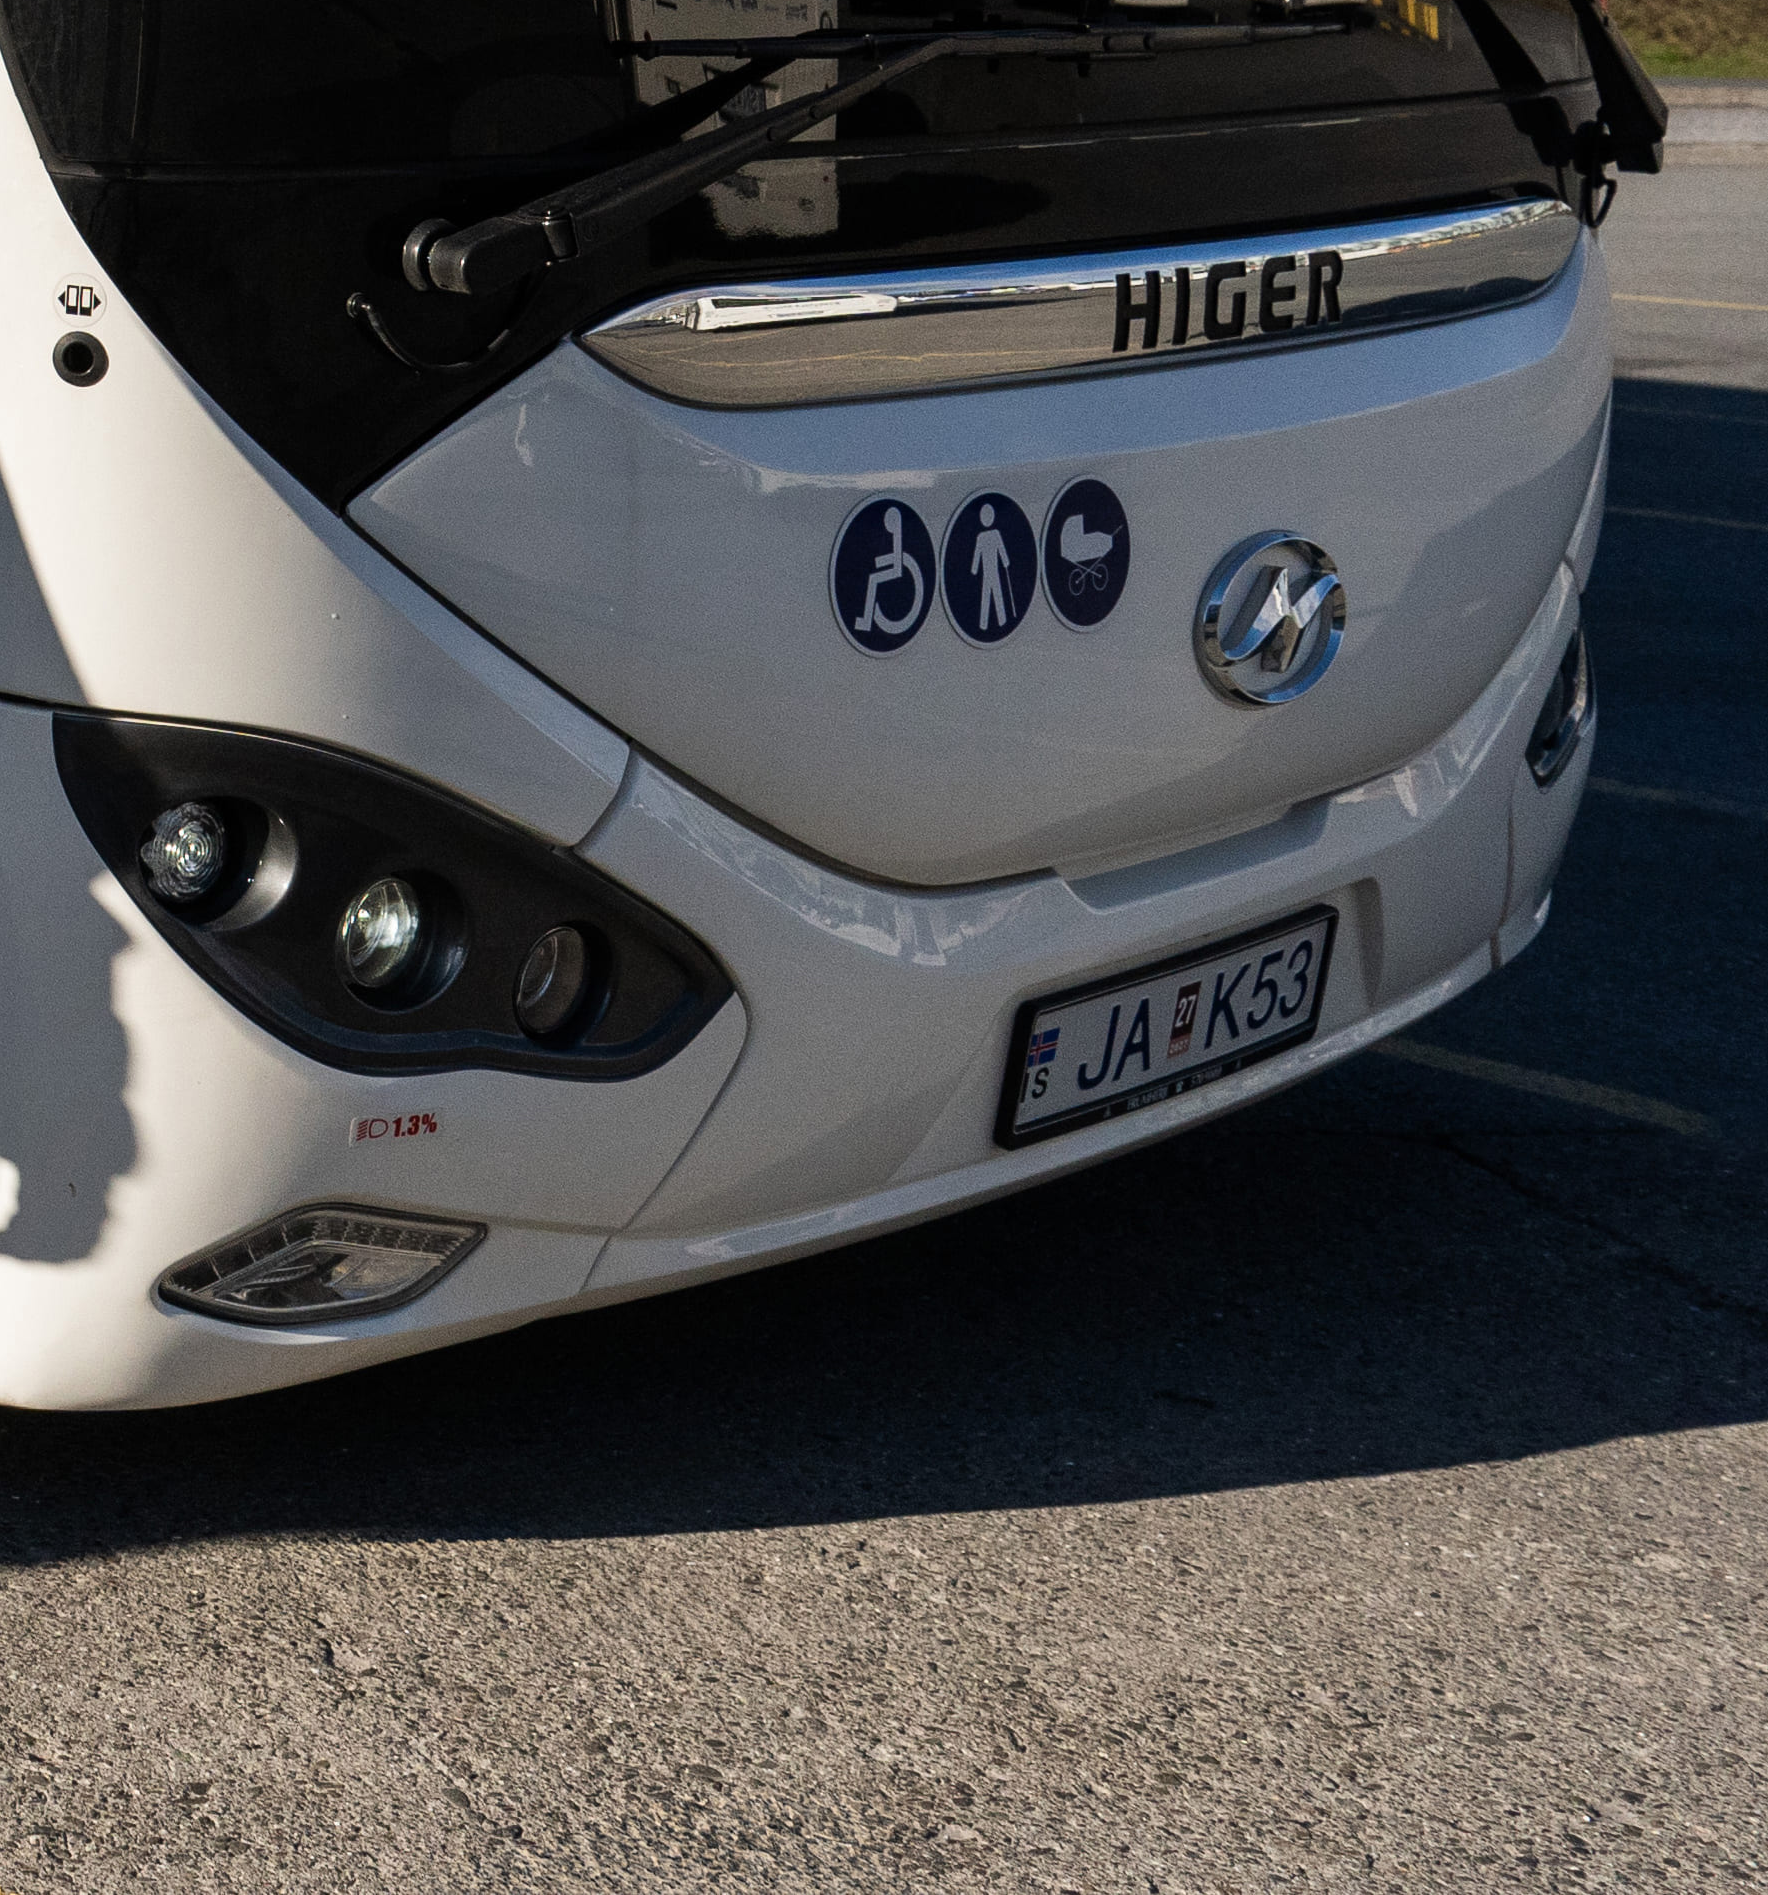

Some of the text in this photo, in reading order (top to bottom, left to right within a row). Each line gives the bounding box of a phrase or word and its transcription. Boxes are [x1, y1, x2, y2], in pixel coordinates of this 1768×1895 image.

[1113, 250, 1343, 353] HIGER
[1077, 939, 1313, 1090] JA K53
[1174, 993, 1197, 1028] 27
[392, 1113, 438, 1138] 1.3%
